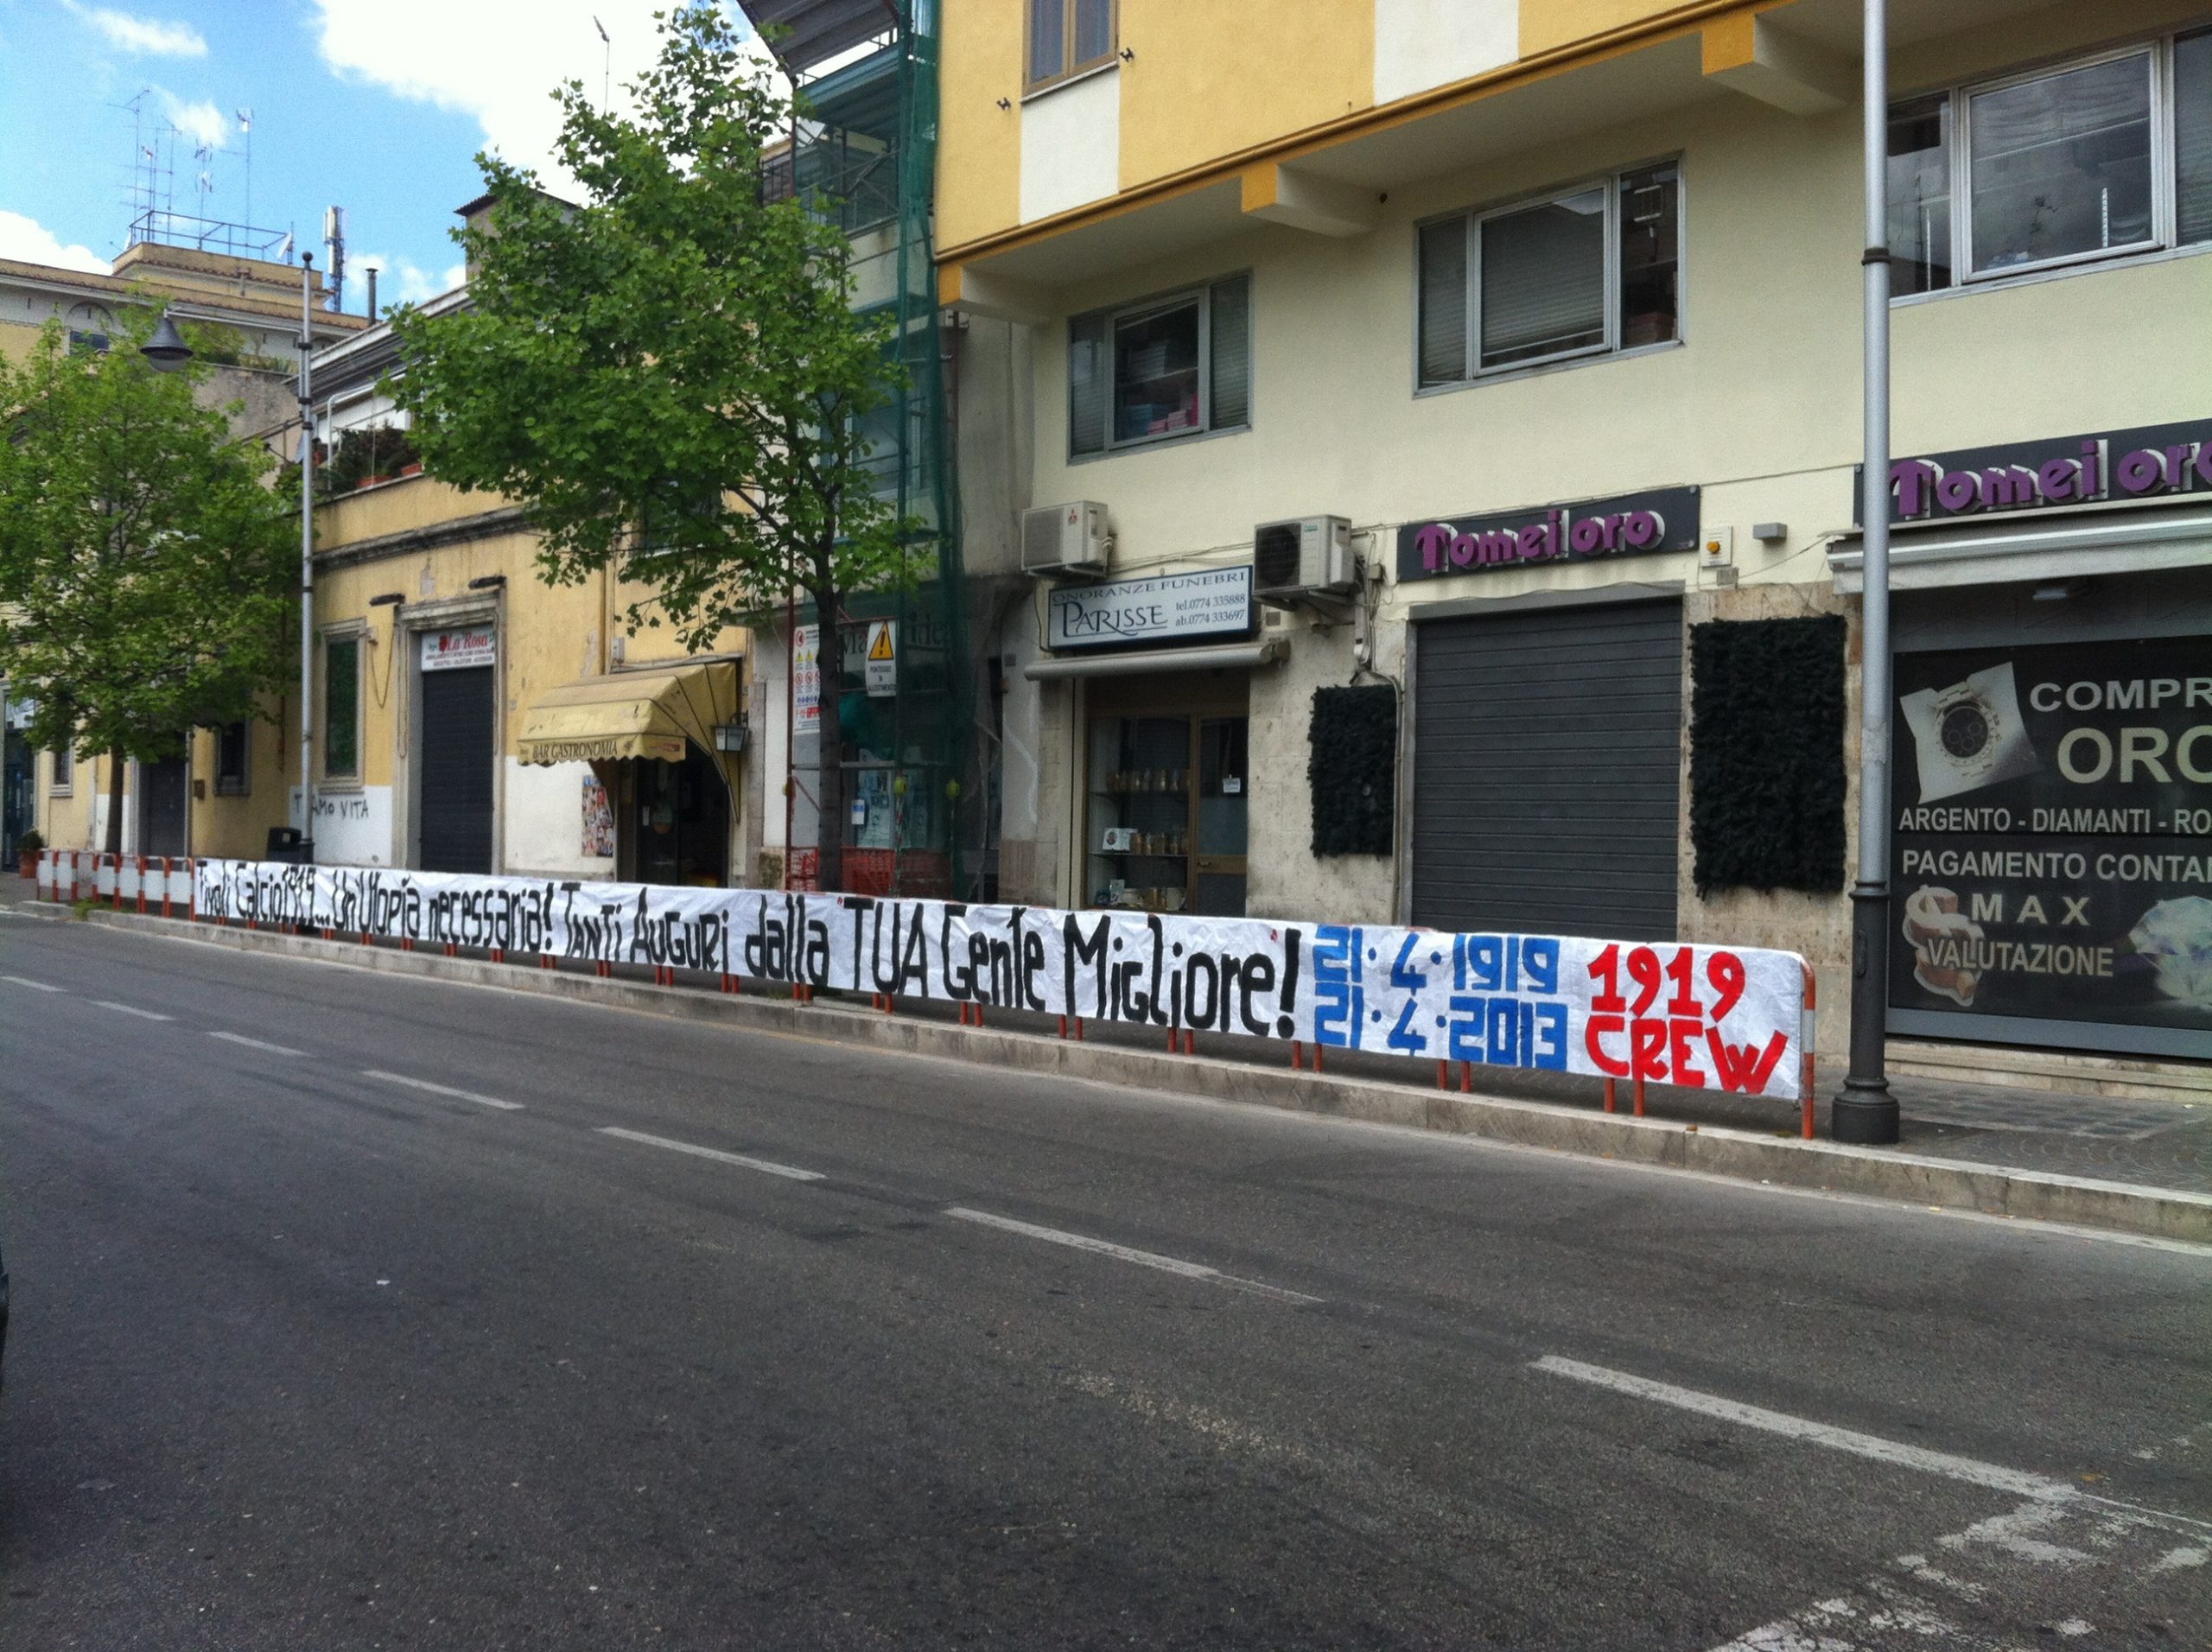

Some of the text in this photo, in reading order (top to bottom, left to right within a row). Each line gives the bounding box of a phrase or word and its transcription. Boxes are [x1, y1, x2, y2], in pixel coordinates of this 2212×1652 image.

[1890, 438, 2108, 522] Tomei
[1414, 509, 1666, 574] Tomei oro
[1052, 571, 1245, 603] ONORANZE FUNEBRI
[1053, 601, 1168, 638] PARISSE
[532, 745, 550, 759] BAR
[2057, 724, 2212, 784] ORO
[340, 798, 369, 821] VITA
[1899, 808, 2012, 831] ARGENTO
[2033, 809, 2152, 833] DIAMANTI
[1903, 850, 2087, 880] PAGAMENTO
[429, 882, 555, 954] necessaria!
[745, 893, 830, 988] dalla
[844, 897, 929, 999] TUA
[941, 904, 1046, 1012] Gente
[1928, 938, 2114, 978] VALUTAZIONE
[1586, 944, 1746, 1023] 1919
[1585, 1014, 1789, 1096] CREW
